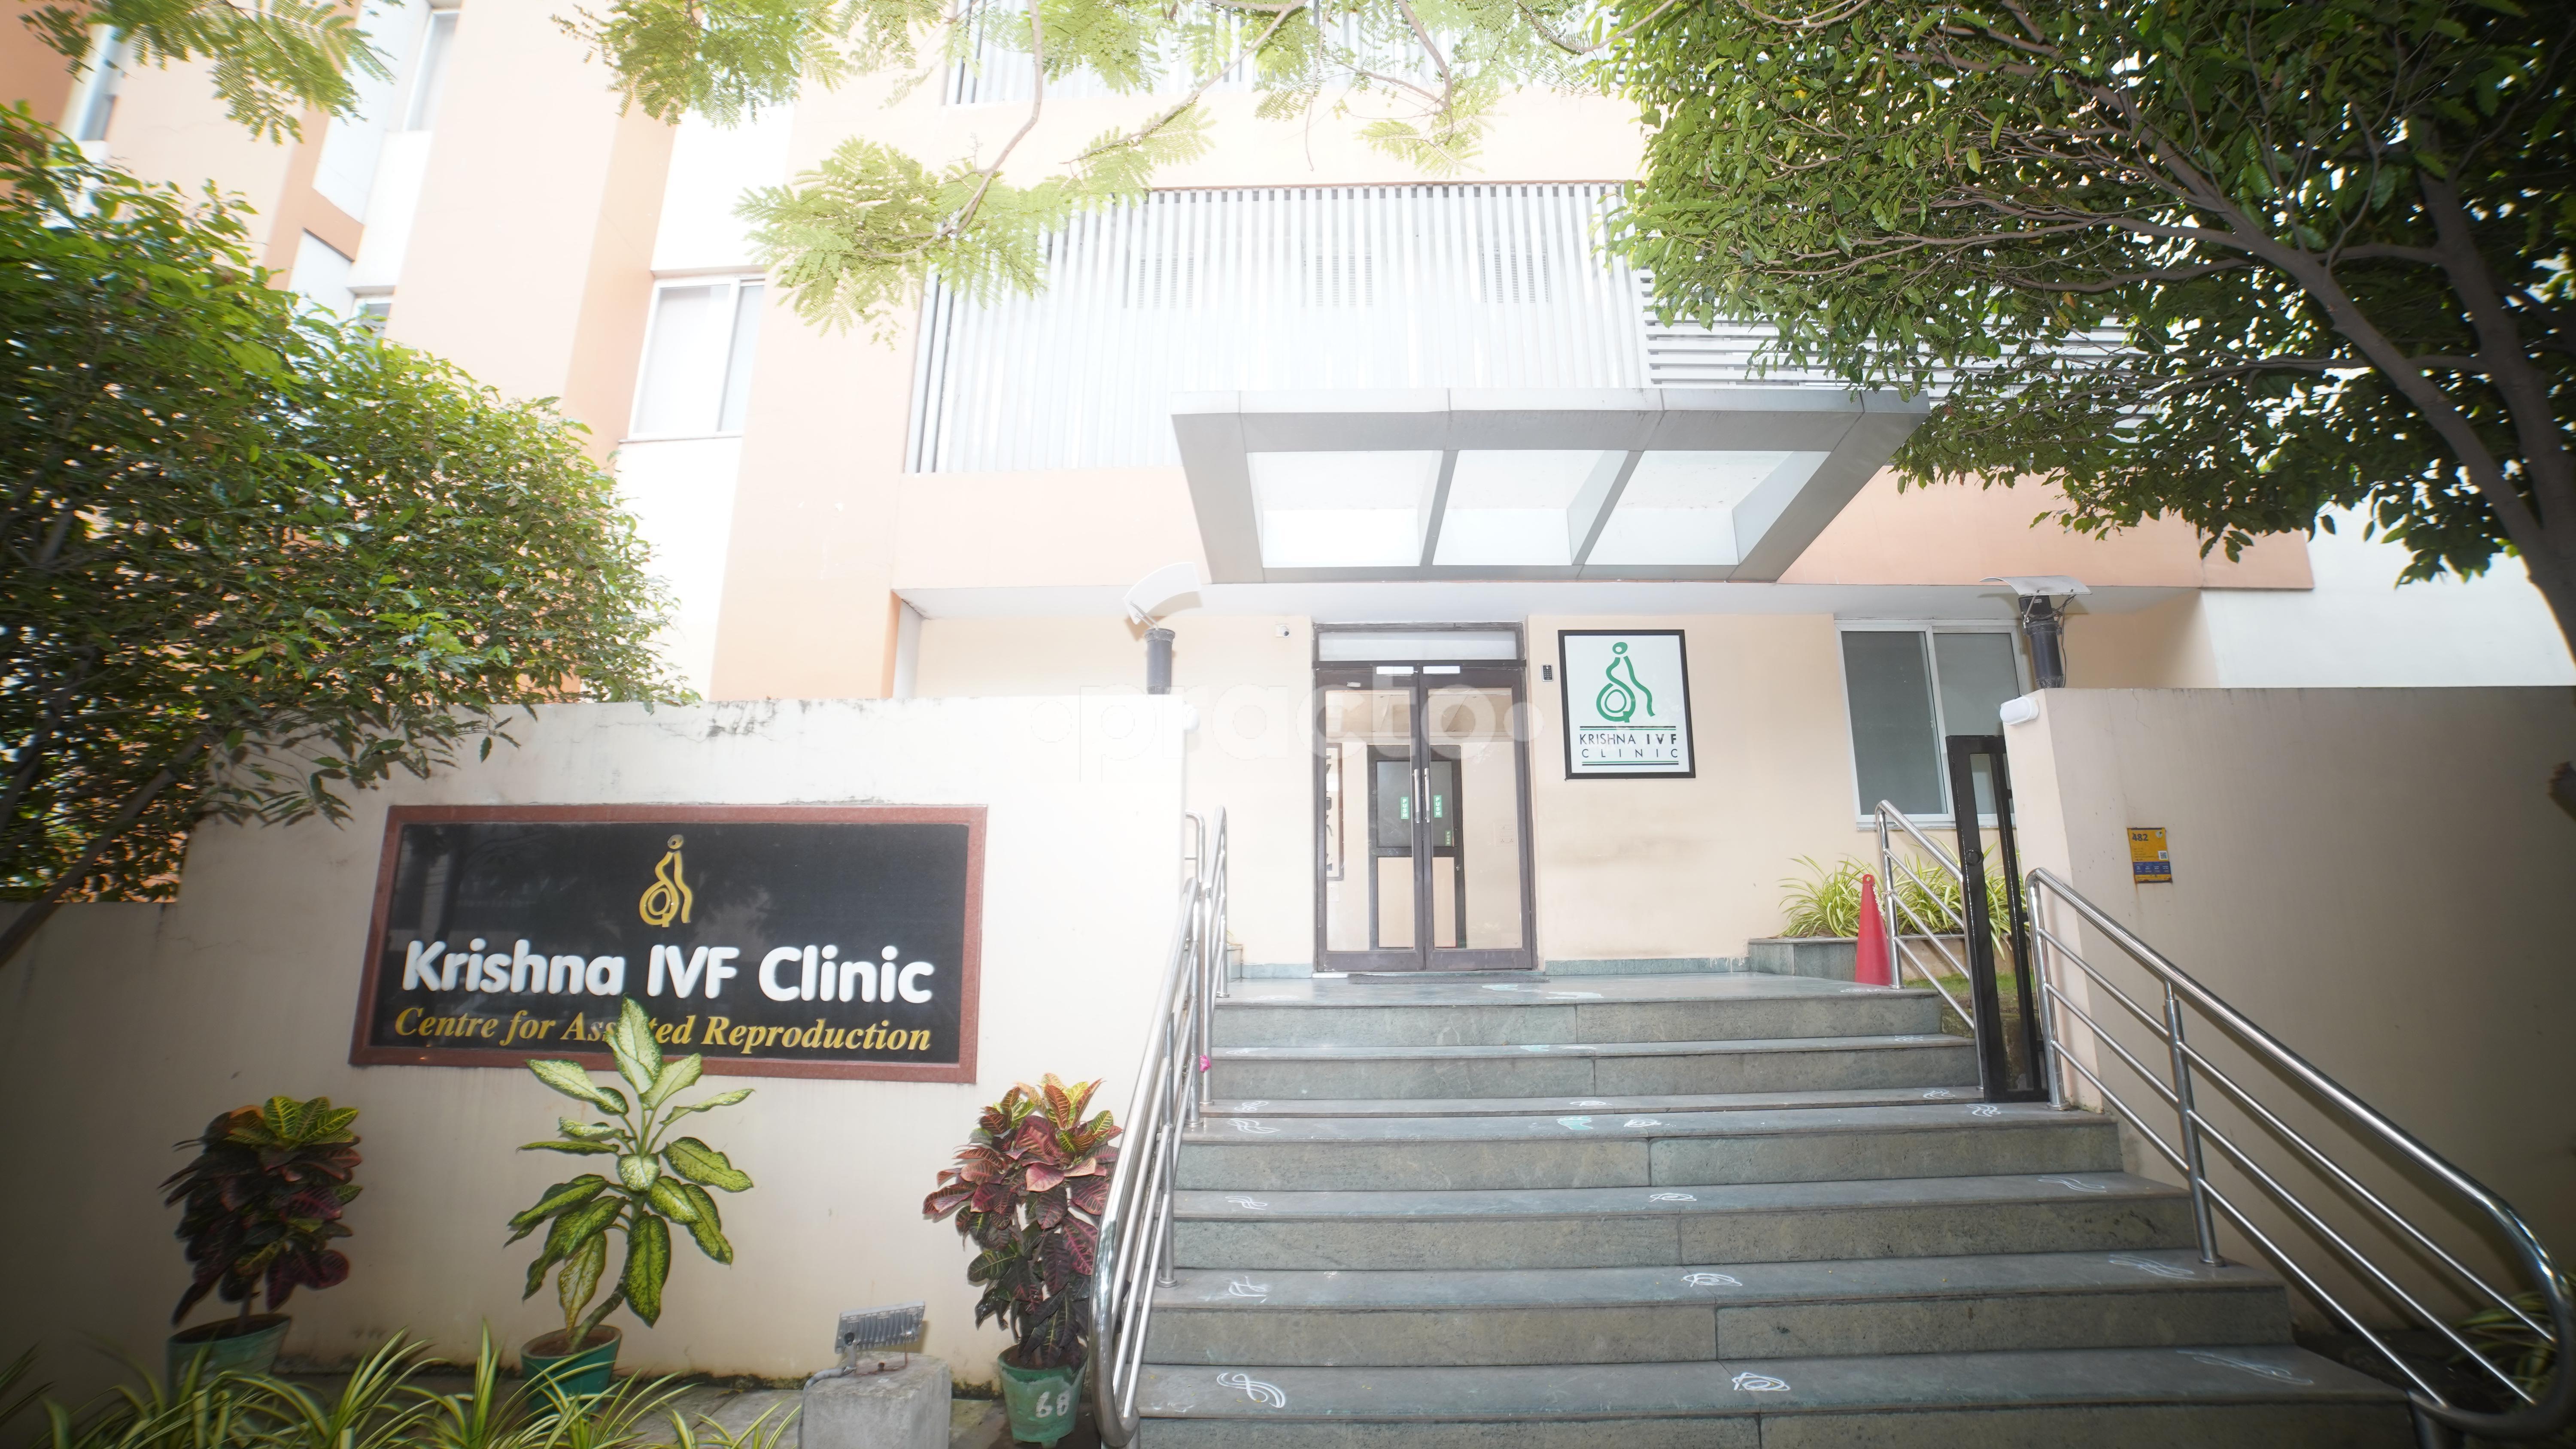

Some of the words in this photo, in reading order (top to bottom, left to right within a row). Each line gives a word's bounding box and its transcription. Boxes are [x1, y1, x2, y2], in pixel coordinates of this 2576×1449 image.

[1580, 734, 1636, 745] KRISHNA
[1646, 734, 1677, 745] IVF
[1582, 749, 1678, 758] CLINIC
[2132, 833, 2148, 841] 482
[401, 937, 626, 996] Krishna
[647, 944, 740, 999] IVF
[758, 944, 936, 1003] Clinic
[395, 1007, 498, 1038] Centre
[499, 1010, 556, 1046] for
[560, 1012, 697, 1045] Assed
[701, 1016, 931, 1054] Reproduction
